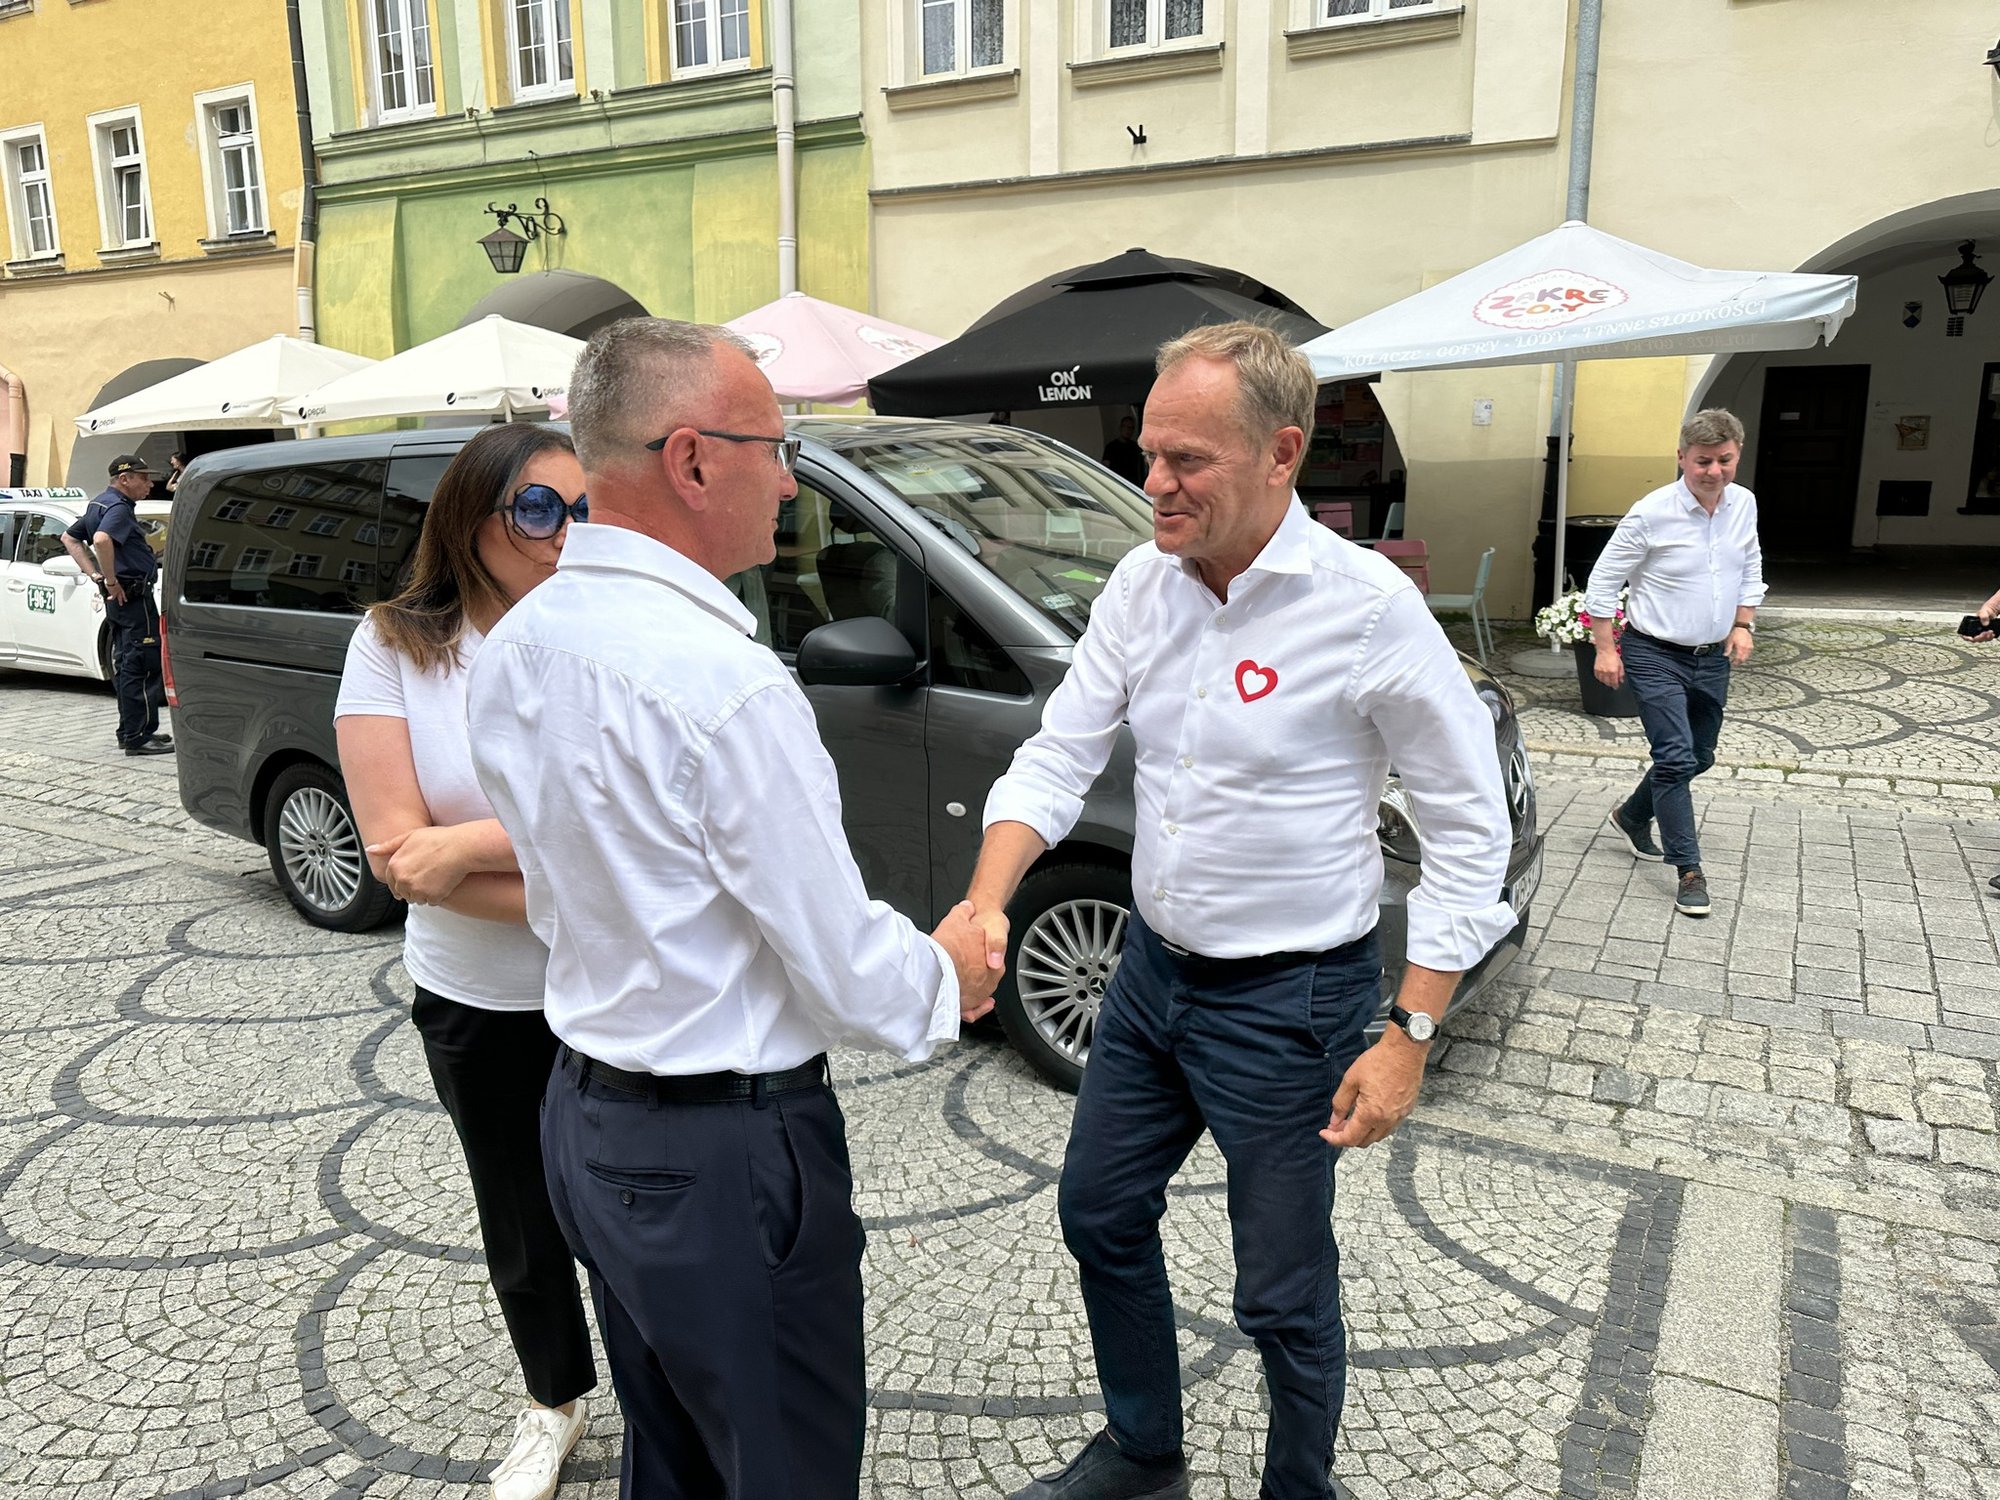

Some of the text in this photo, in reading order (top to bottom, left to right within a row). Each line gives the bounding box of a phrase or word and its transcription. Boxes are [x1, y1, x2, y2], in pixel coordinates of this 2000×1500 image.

[1436, 339, 1500, 358] GOFRY
[1514, 330, 1567, 348] LODY
[1051, 371, 1076, 386] ON
[1038, 385, 1091, 402] LEMON
[307, 404, 327, 418] pepsi
[98, 416, 116, 428] pepsi
[20, 489, 43, 498] TAXI
[28, 589, 54, 610] 1-96-21
